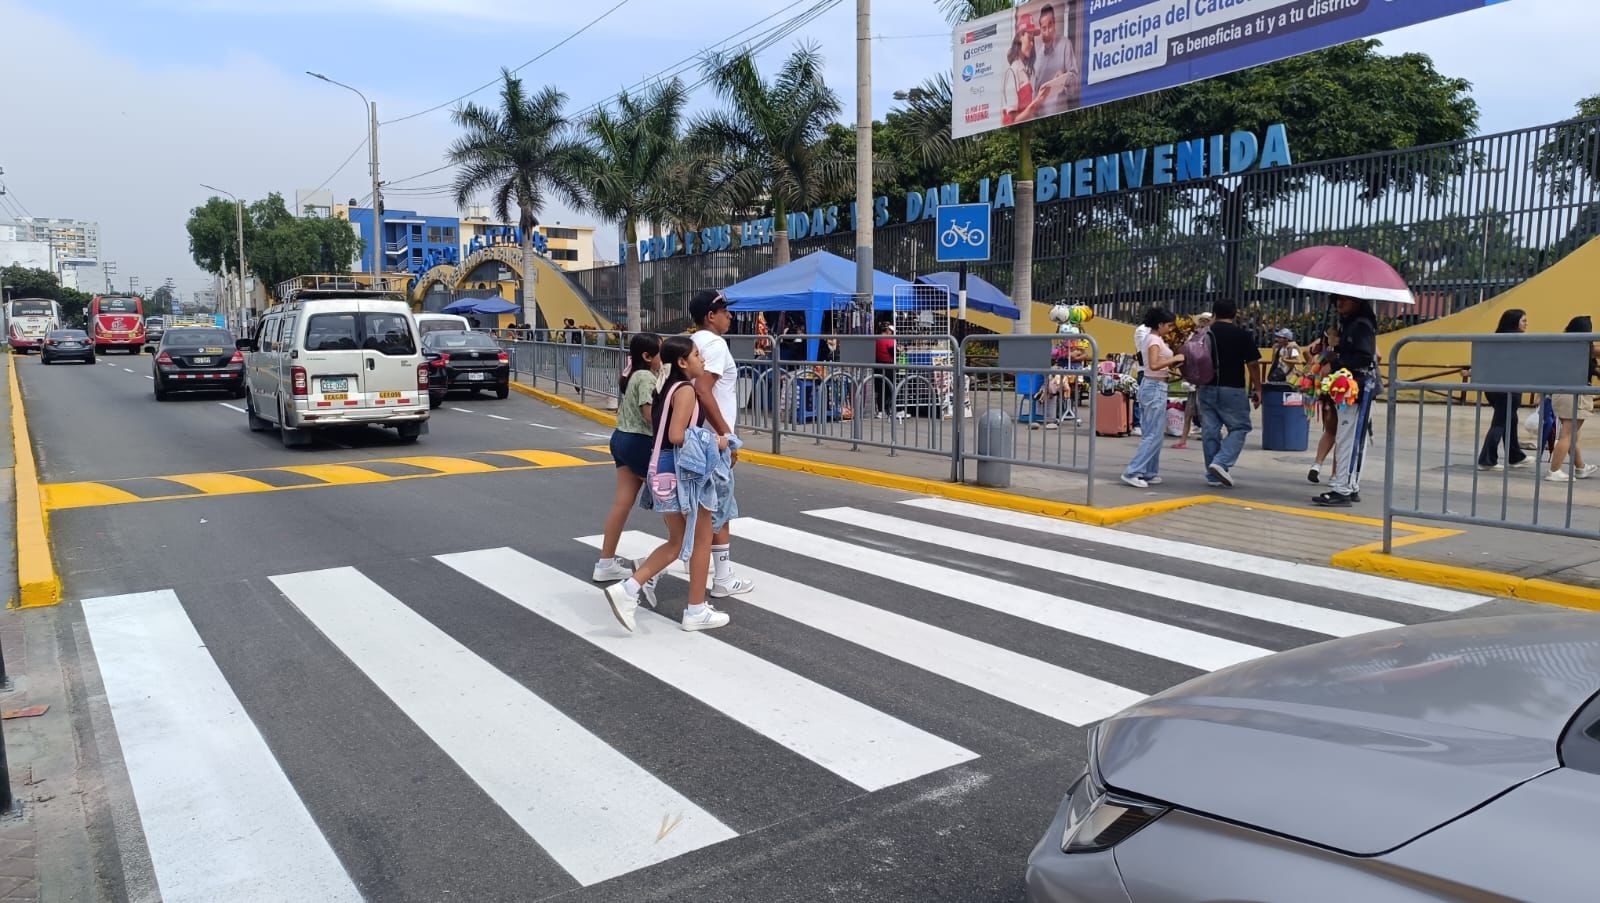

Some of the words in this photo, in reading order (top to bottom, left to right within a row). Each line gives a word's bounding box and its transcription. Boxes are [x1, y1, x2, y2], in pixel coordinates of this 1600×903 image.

[1093, 14, 1161, 48] Participa
[1165, 0, 1190, 26] del
[1171, 41, 1185, 57] Te
[1186, 23, 1242, 53] beneficia
[1244, 24, 1253, 37] a
[1255, 15, 1265, 33] ti
[1267, 16, 1277, 34] y
[1278, 13, 1287, 27] a
[1290, 7, 1304, 24] tu
[1092, 35, 1158, 71] Nacional
[701, 223, 732, 253] SUS
[740, 205, 839, 248] LEYNDAS
[1036, 123, 1293, 203] BIENVENIDA
